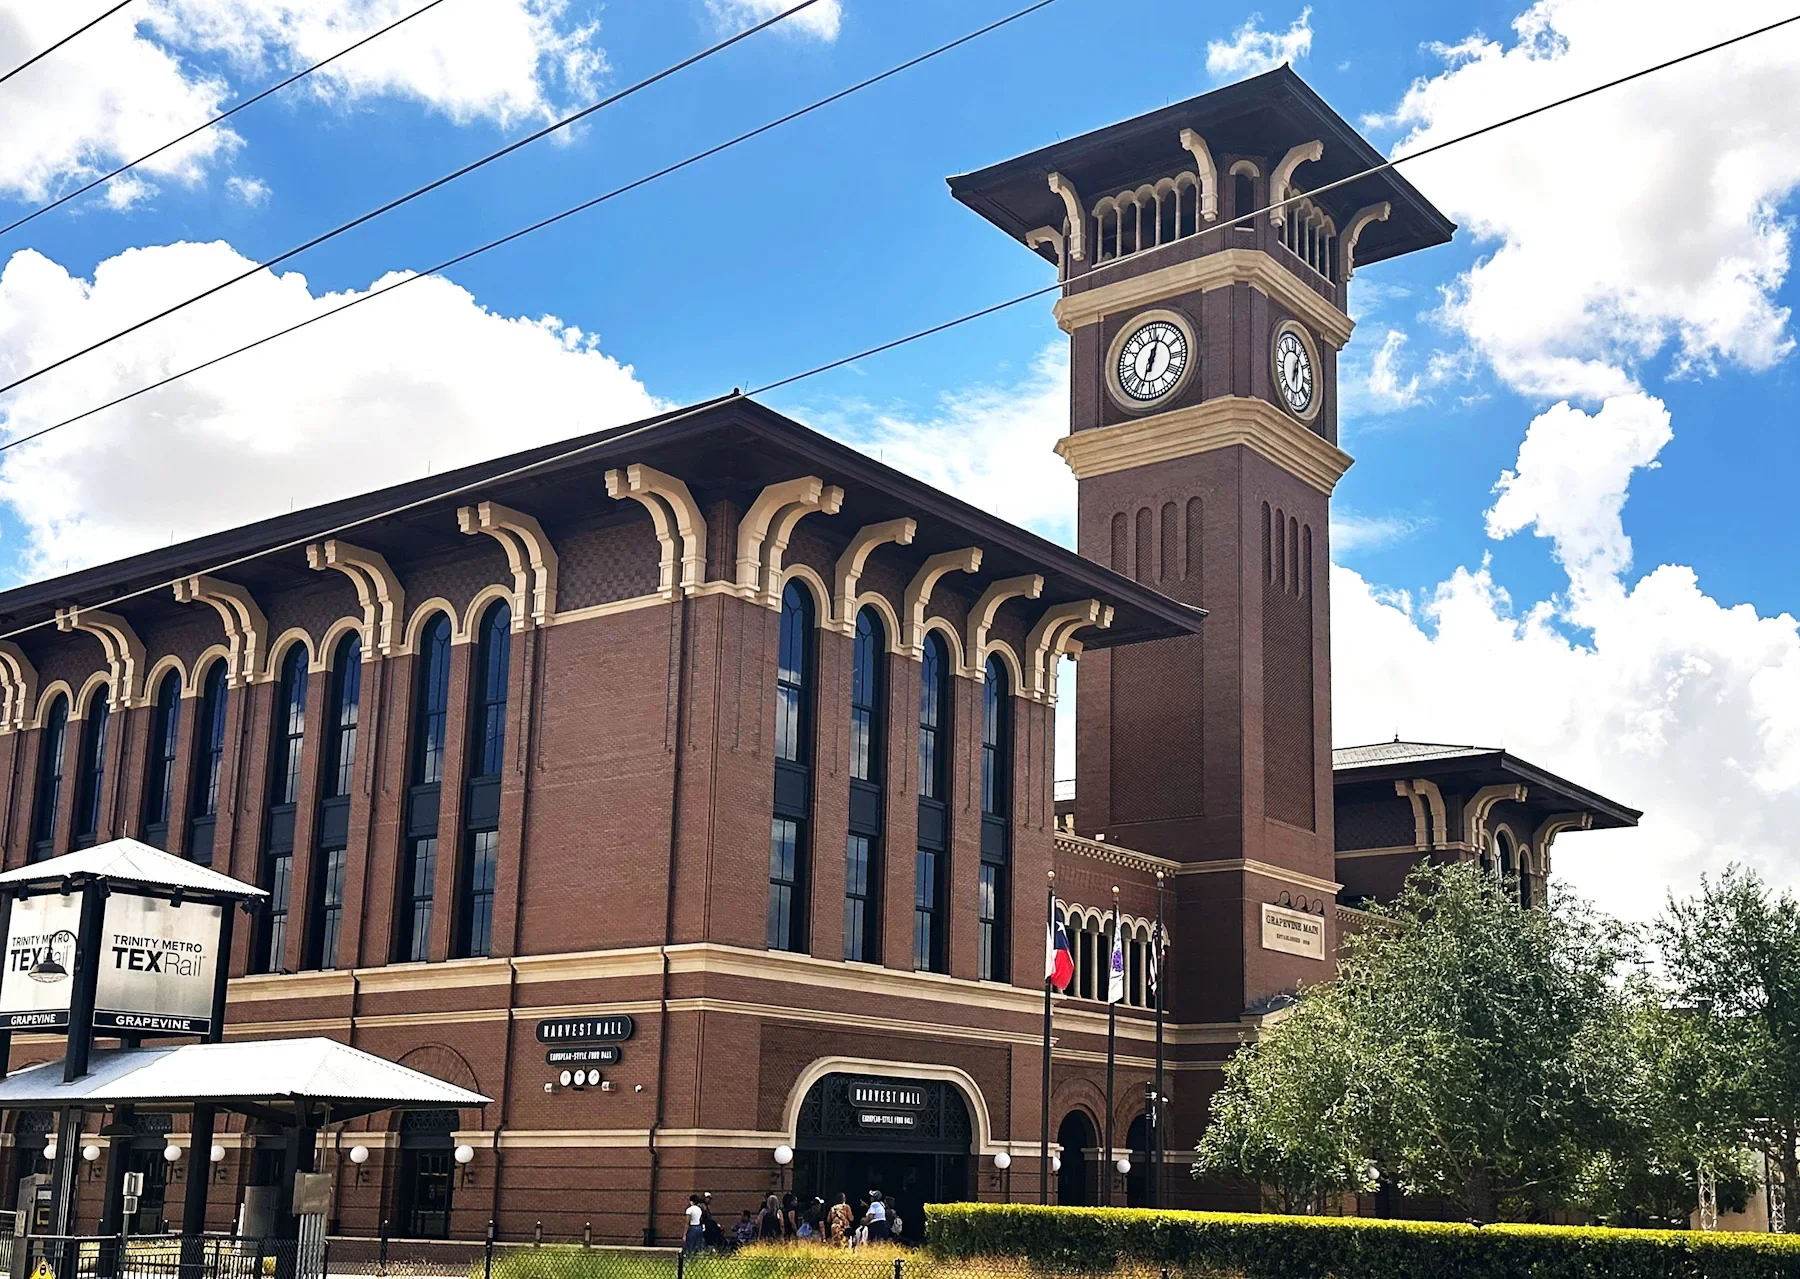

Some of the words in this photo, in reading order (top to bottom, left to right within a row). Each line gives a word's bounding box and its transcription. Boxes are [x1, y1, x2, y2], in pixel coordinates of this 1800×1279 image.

[1266, 914, 1302, 931] GRAPEVINE
[1302, 923, 1319, 935] MAIN
[12, 935, 40, 947] TRINITY
[113, 934, 159, 949] TRINITY
[162, 940, 203, 953] METRO
[112, 946, 202, 977] TEXRail
[11, 1013, 56, 1026] GRAPEVINE
[116, 1015, 190, 1030] GRAPEVINE
[543, 1022, 592, 1038] HARVEST
[596, 1021, 622, 1036] HALL
[856, 1088, 897, 1103] HARVEST
[900, 1091, 921, 1105] HALL
